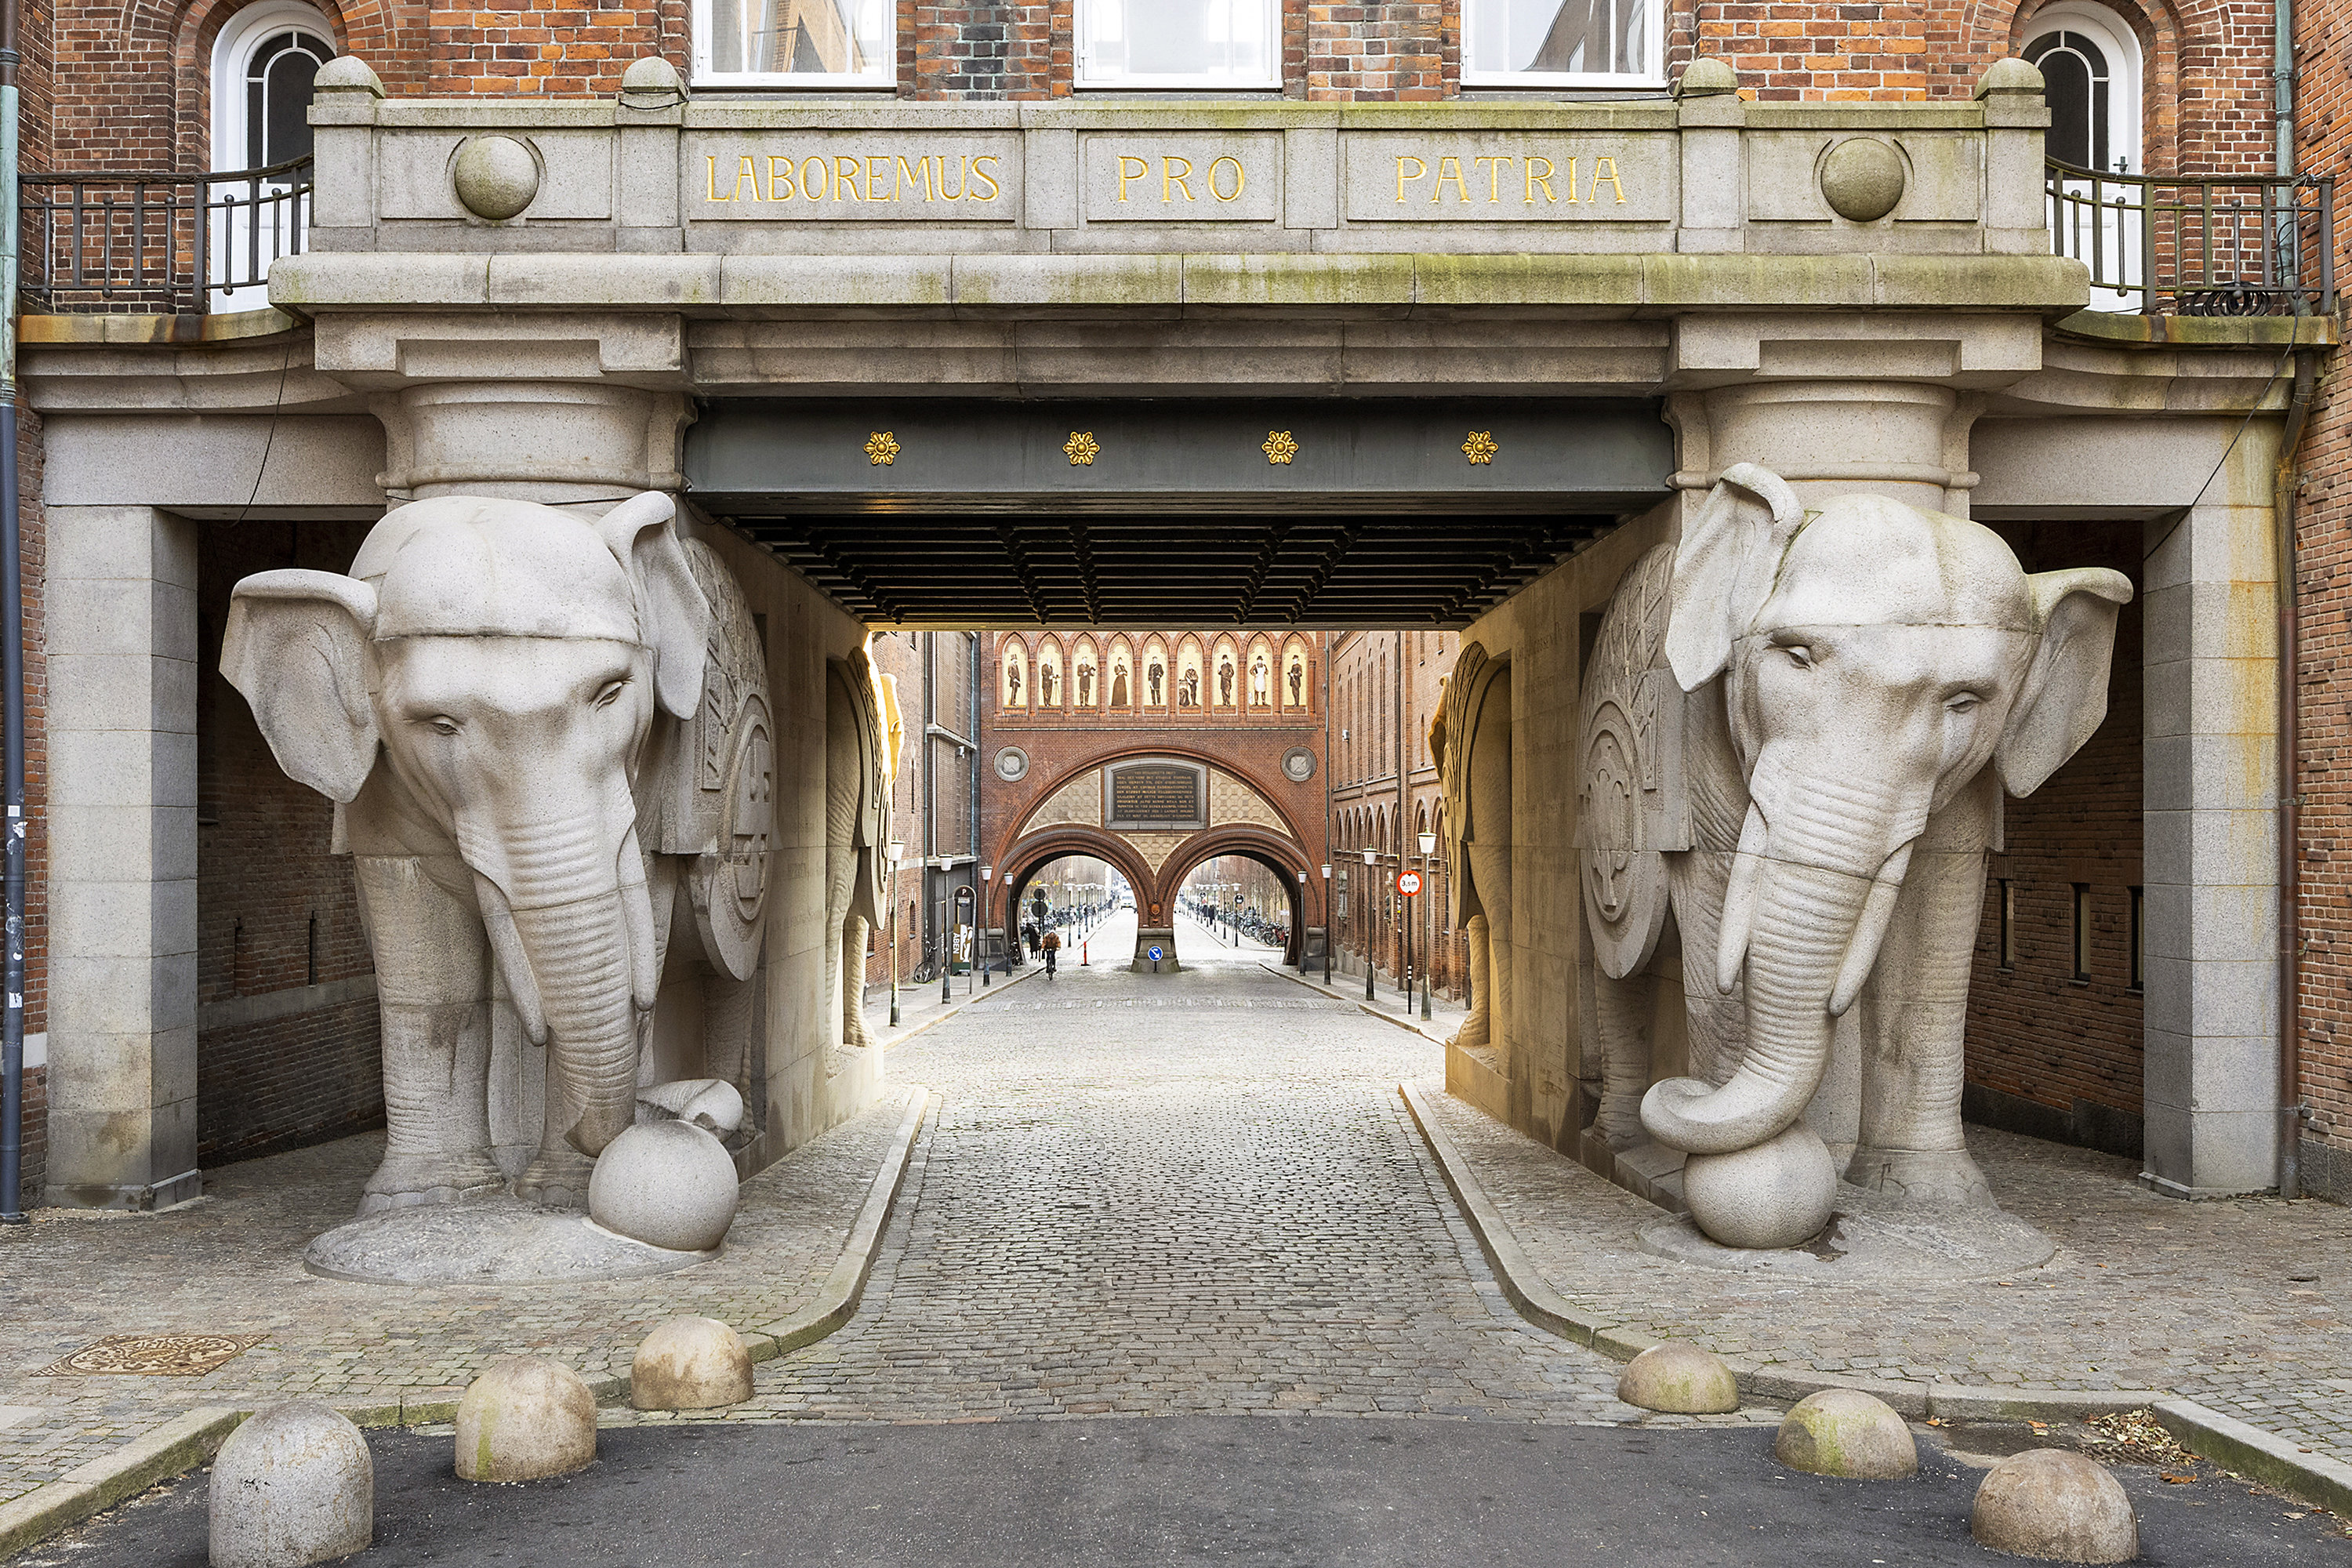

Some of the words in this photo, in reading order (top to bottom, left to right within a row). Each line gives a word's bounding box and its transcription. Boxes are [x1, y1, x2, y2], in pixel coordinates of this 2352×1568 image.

[706, 155, 1000, 202] LABOREMUS
[1116, 155, 1246, 202] PRO
[1395, 156, 1627, 203] PATRIA
